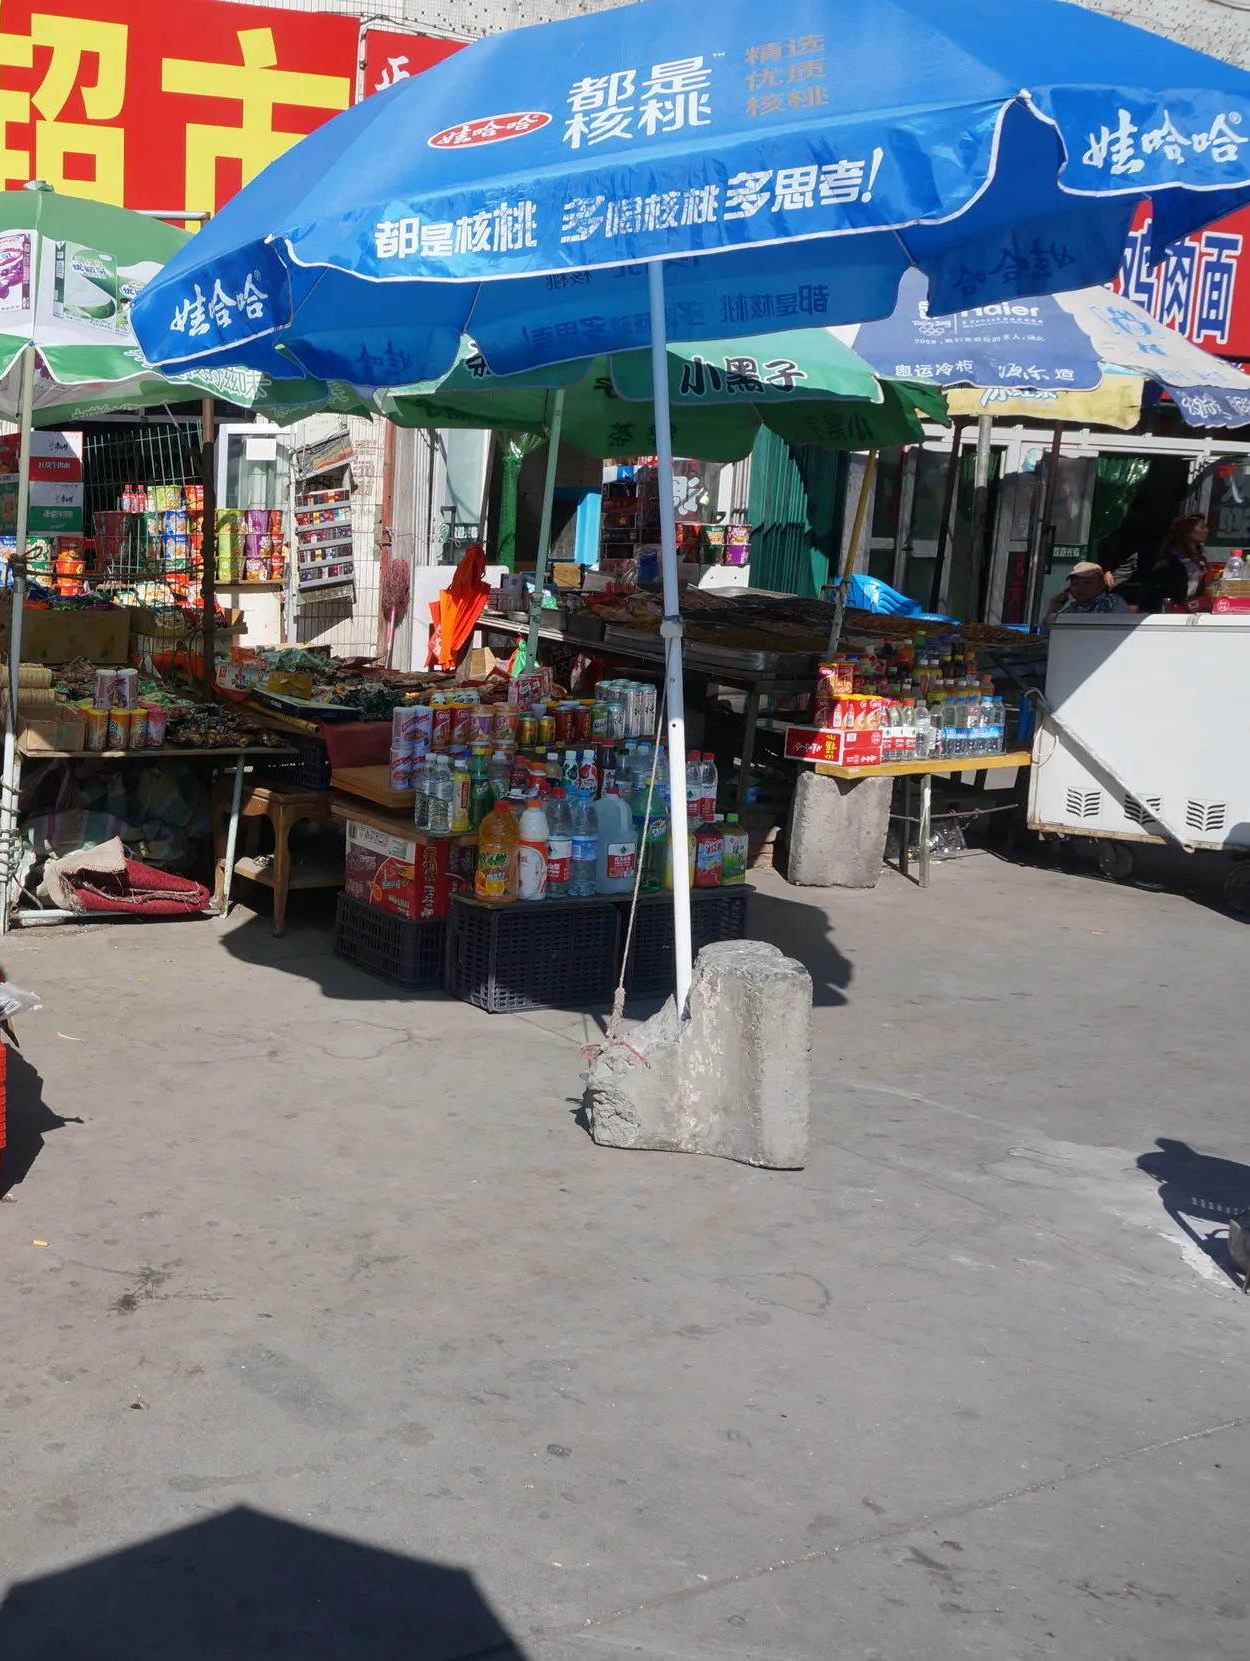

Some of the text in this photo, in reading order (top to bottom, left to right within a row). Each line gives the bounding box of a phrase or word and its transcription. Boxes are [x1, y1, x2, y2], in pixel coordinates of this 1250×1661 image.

[744, 35, 825, 65] 精选
[566, 56, 712, 110] 都是
[746, 58, 826, 91] 优质
[562, 91, 712, 149] 核桃
[746, 86, 830, 117] 核桃
[438, 115, 538, 146] 娃哈哈
[1083, 108, 1248, 175] 娃哈哈
[374, 201, 537, 259] 都是核桃
[170, 273, 268, 336] 娃哈哈
[679, 356, 808, 395] 小黑子
[894, 360, 974, 378] 奥运冷柜
